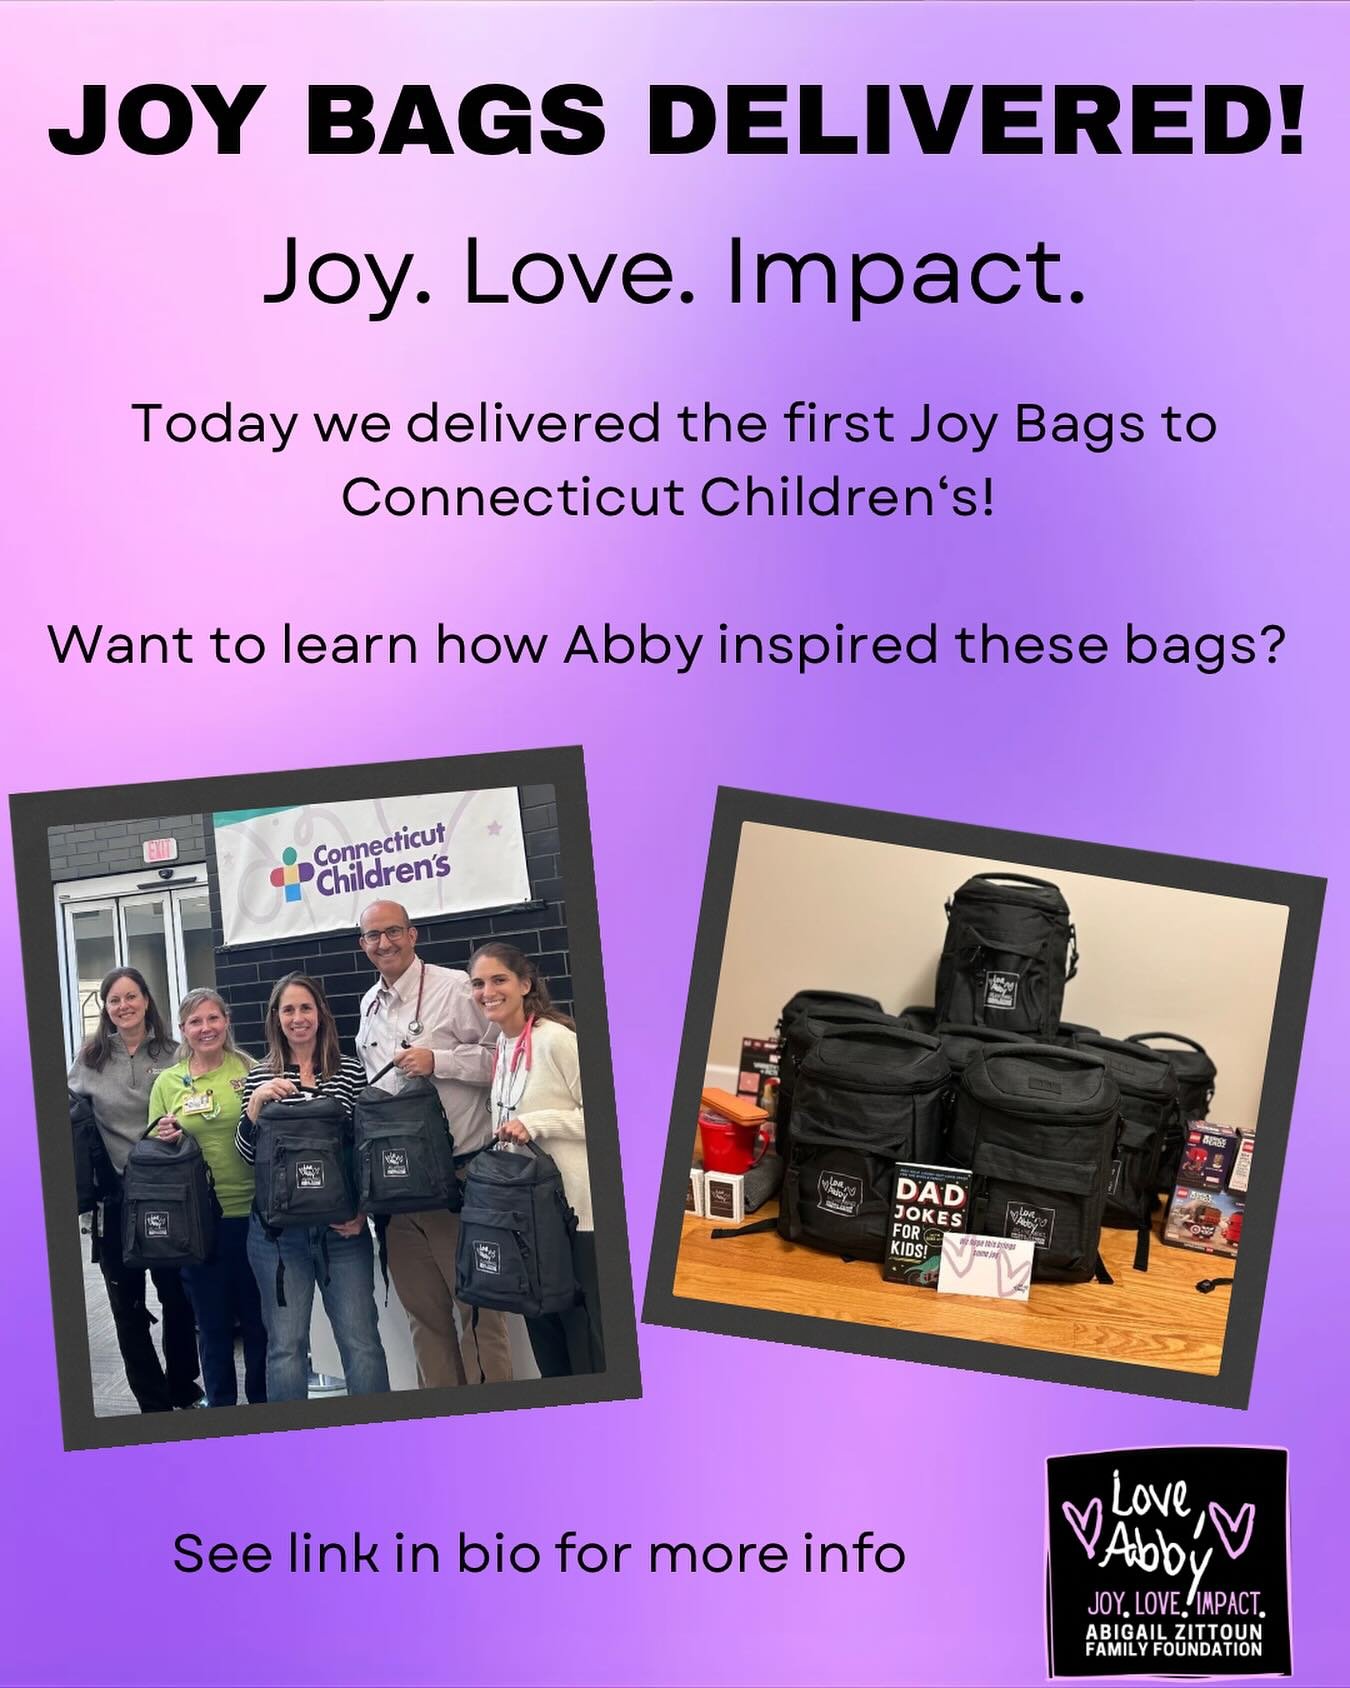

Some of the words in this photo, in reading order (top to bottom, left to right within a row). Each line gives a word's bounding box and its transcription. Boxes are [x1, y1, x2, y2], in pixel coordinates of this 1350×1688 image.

[148, 839, 171, 860] EXIT
[314, 822, 446, 867] Connecticut
[316, 853, 451, 896] Children's
[896, 1177, 967, 1208] DAD
[894, 1204, 963, 1228] JOKES
[892, 1222, 921, 1241] FOR
[890, 1240, 928, 1260] KIDS!
